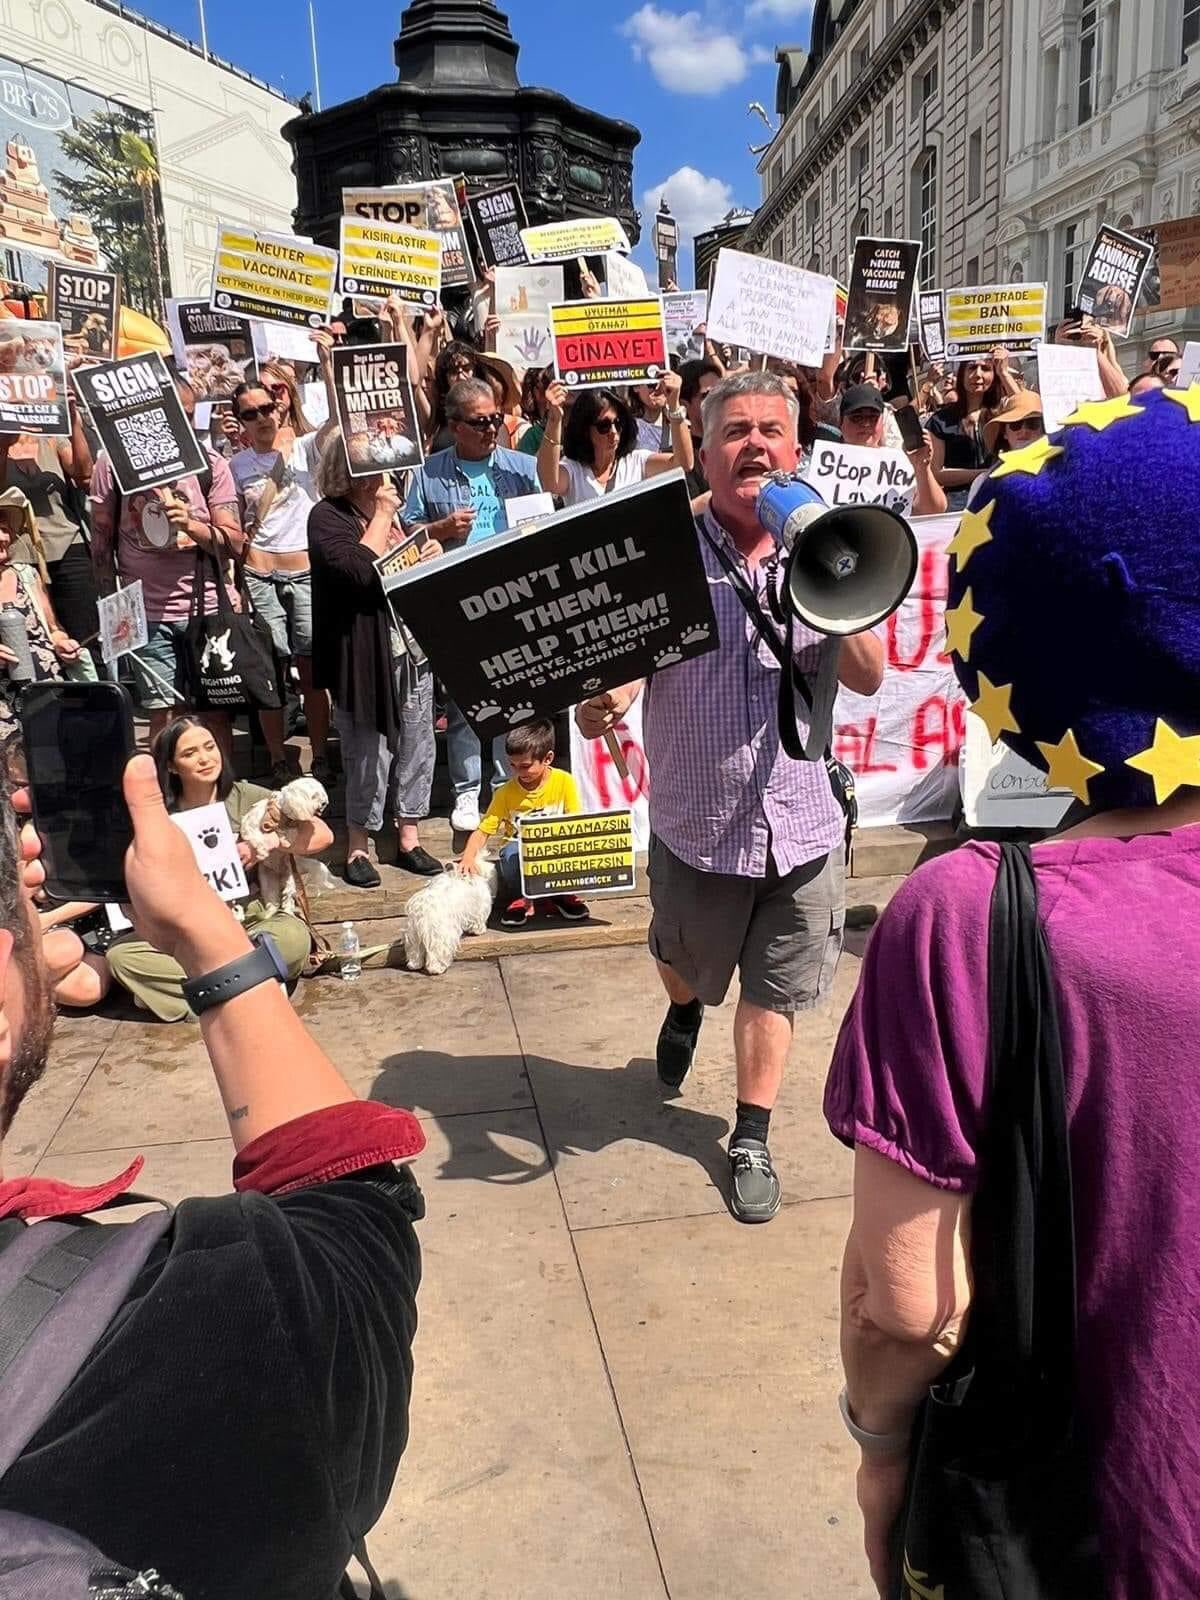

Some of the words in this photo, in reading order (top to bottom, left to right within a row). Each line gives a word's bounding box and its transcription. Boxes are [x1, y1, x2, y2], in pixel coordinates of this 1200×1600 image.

[355, 202, 420, 223] STOP
[477, 192, 515, 218] SIGN
[362, 230, 426, 249] KISIRLAŞTIR
[256, 241, 305, 263] NEUTER
[376, 250, 413, 264] AŞILAT
[874, 249, 900, 258] CATCH
[1094, 242, 1140, 275] ANIMAL
[242, 258, 314, 287] VACCINATE
[352, 263, 398, 280] YERİNDE
[400, 272, 433, 286] YAŞAT
[862, 269, 905, 279] VACCINATE
[870, 259, 900, 269] NEUTER
[58, 274, 111, 301] STOP
[217, 275, 232, 285] LET
[254, 283, 271, 295] LIVE
[273, 287, 281, 296] IN
[282, 289, 303, 301] THEIR
[866, 279, 898, 289] RELEASE
[1088, 260, 1137, 294] ABUSE
[964, 294, 992, 304] STOP
[993, 291, 1029, 302] TRADE
[584, 306, 629, 317] UYUTMAK
[980, 305, 1010, 318] BAN
[969, 322, 1023, 335] BREEDING
[565, 338, 657, 362] CİNAYET
[91, 361, 160, 402] SIGN
[342, 361, 399, 392] LIVES
[0, 375, 53, 402] STOP
[102, 401, 121, 412] THE
[121, 388, 163, 407] PETITION!
[345, 389, 403, 412] MATTER
[817, 451, 871, 486] Stop
[877, 460, 916, 486] New
[459, 563, 561, 622] DON'T
[569, 537, 645, 580] KILL
[514, 581, 623, 632] THEM,
[480, 635, 559, 679] HELP
[566, 593, 669, 647] THEM!
[491, 656, 572, 689] TURKIYE,
[574, 640, 608, 658] THE
[611, 617, 671, 645] WORLD
[530, 677, 547, 688] IS
[551, 642, 637, 680] WATCHING
[200, 674, 242, 686] FIGHTING
[207, 687, 240, 696] ANIMAL
[208, 696, 246, 706] TESTING
[525, 818, 629, 838] TOPLAYAMAZSIN
[204, 862, 241, 892] K!
